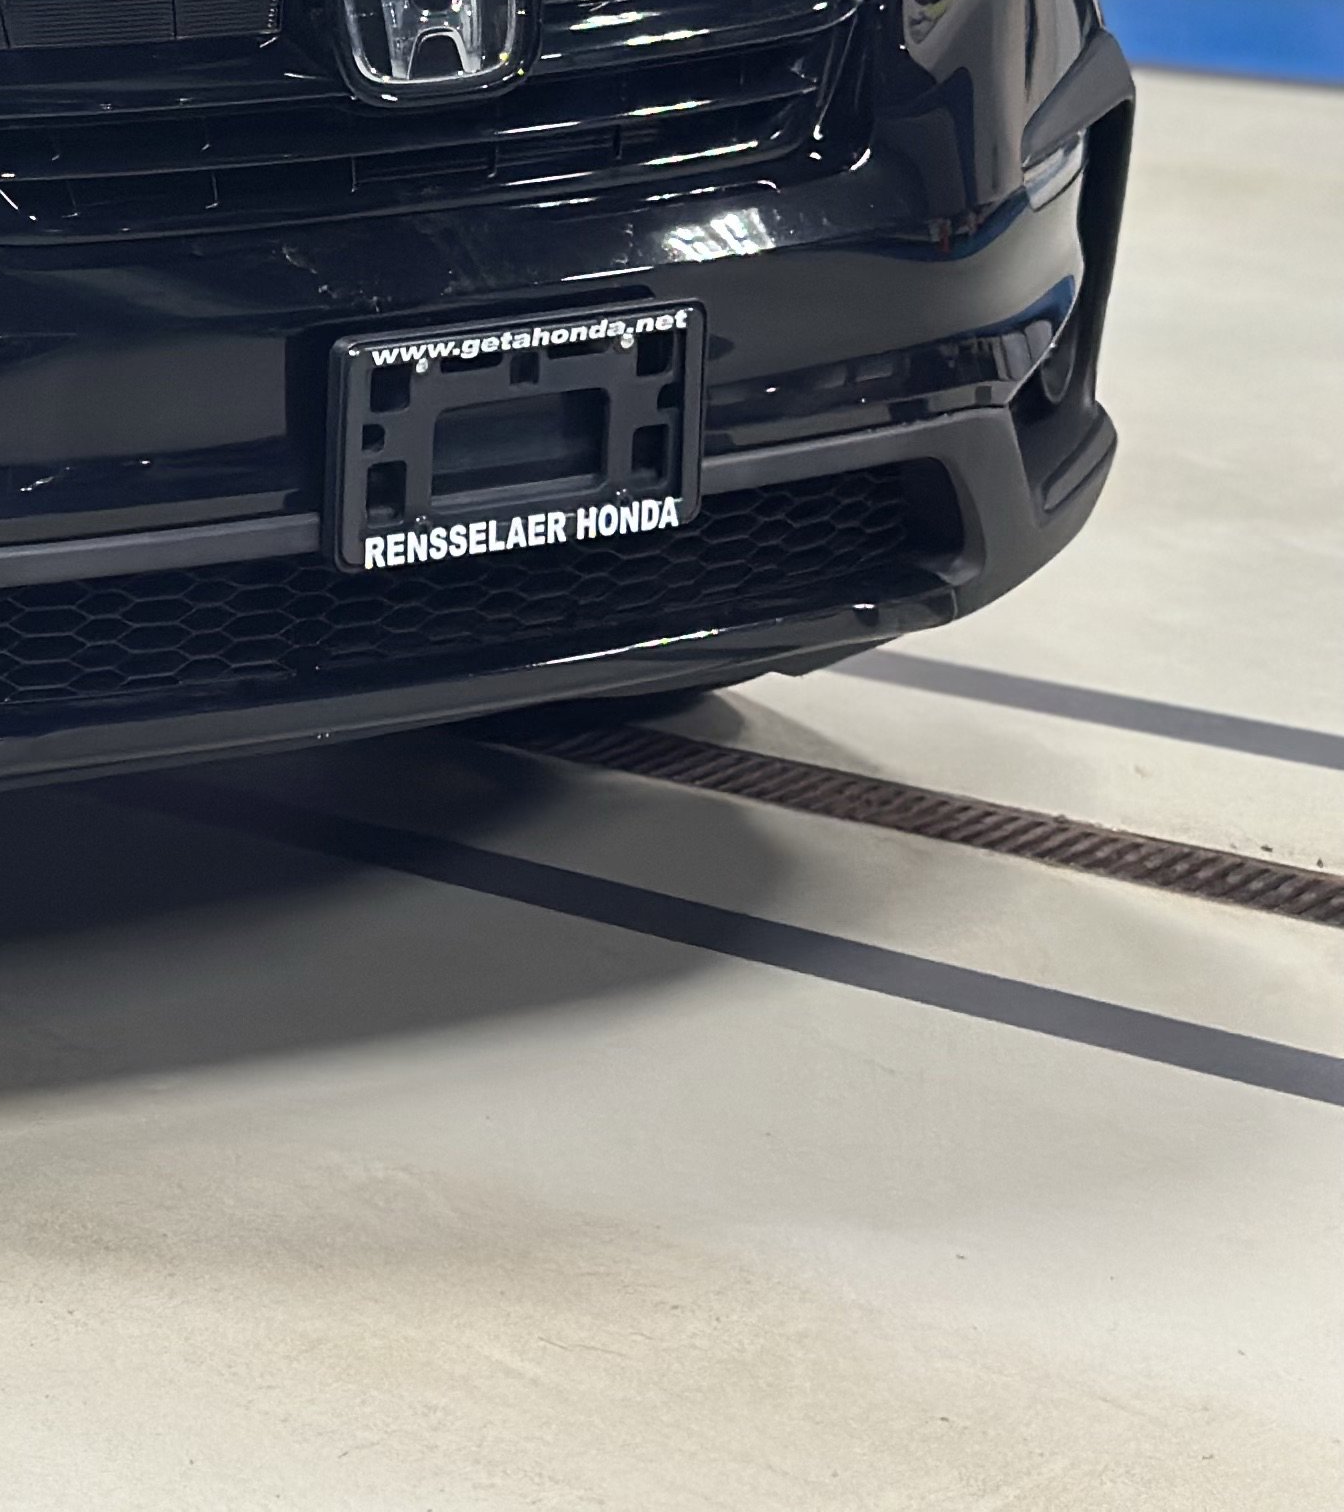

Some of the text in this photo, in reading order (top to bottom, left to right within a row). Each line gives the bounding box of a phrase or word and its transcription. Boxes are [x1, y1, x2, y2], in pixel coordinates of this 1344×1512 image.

[371, 309, 688, 367] www.getahonda.net
[364, 496, 680, 570] RENSSELAER HONDA
